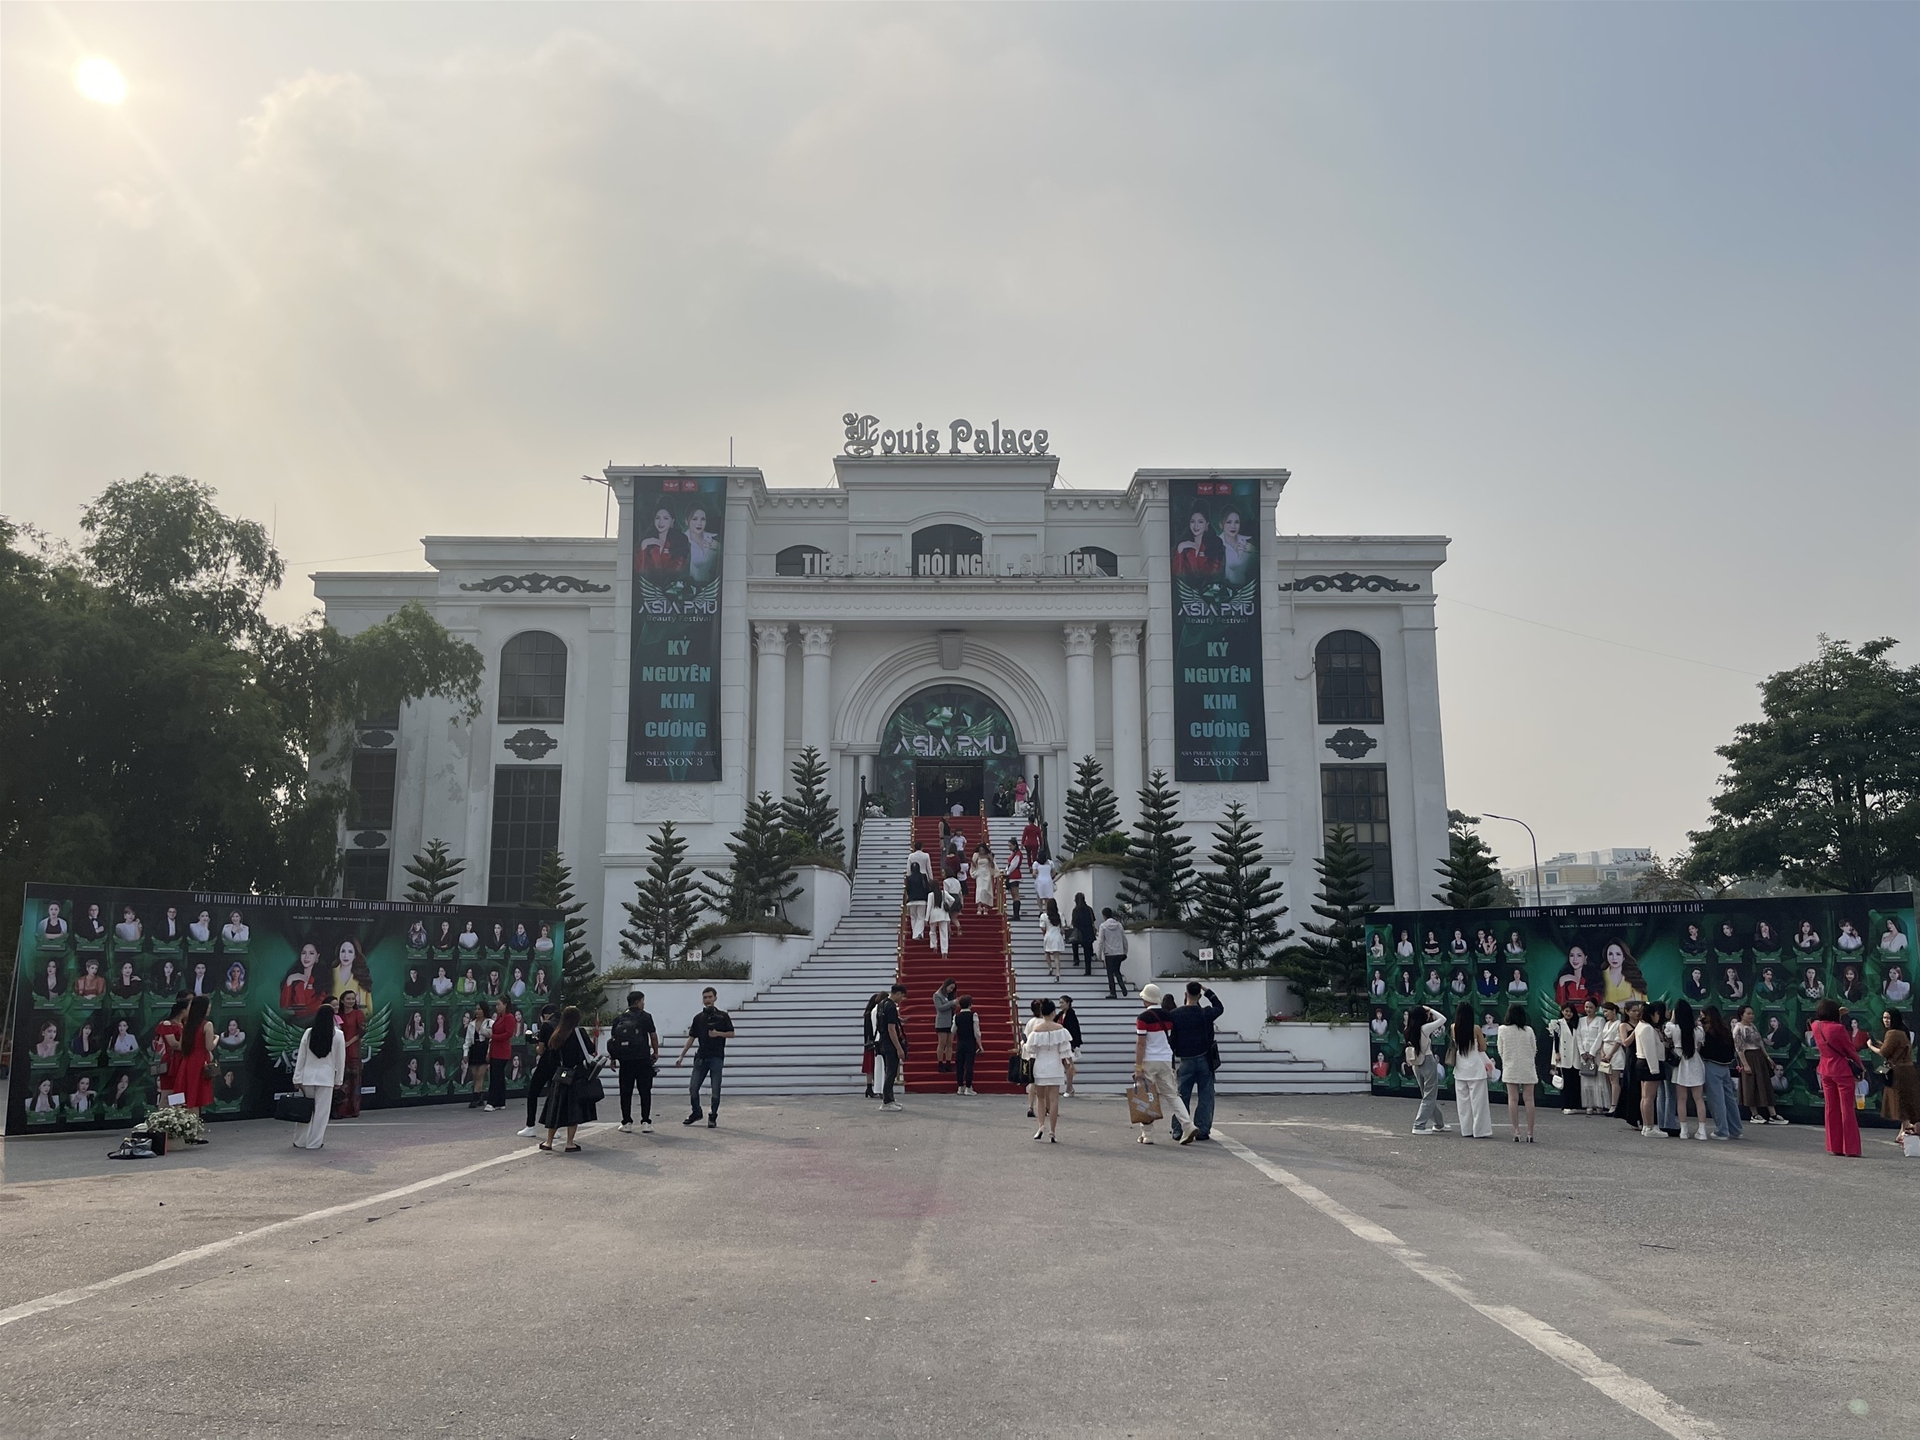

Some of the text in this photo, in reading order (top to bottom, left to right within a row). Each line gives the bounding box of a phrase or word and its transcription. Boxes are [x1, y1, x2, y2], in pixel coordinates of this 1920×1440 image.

[842, 412, 1049, 458] Louis Palace
[638, 600, 718, 614] ASIA PMU
[1178, 602, 1255, 616] ASIA PMU
[642, 664, 711, 682] NGUYÊN
[1184, 665, 1251, 683] NGUYÊN
[661, 693, 695, 709] KIM
[1203, 694, 1237, 709] KIM
[893, 735, 1007, 754] ASIA PMU
[646, 757, 703, 767] SEASON 3
[1193, 757, 1249, 767] SEASON 3
